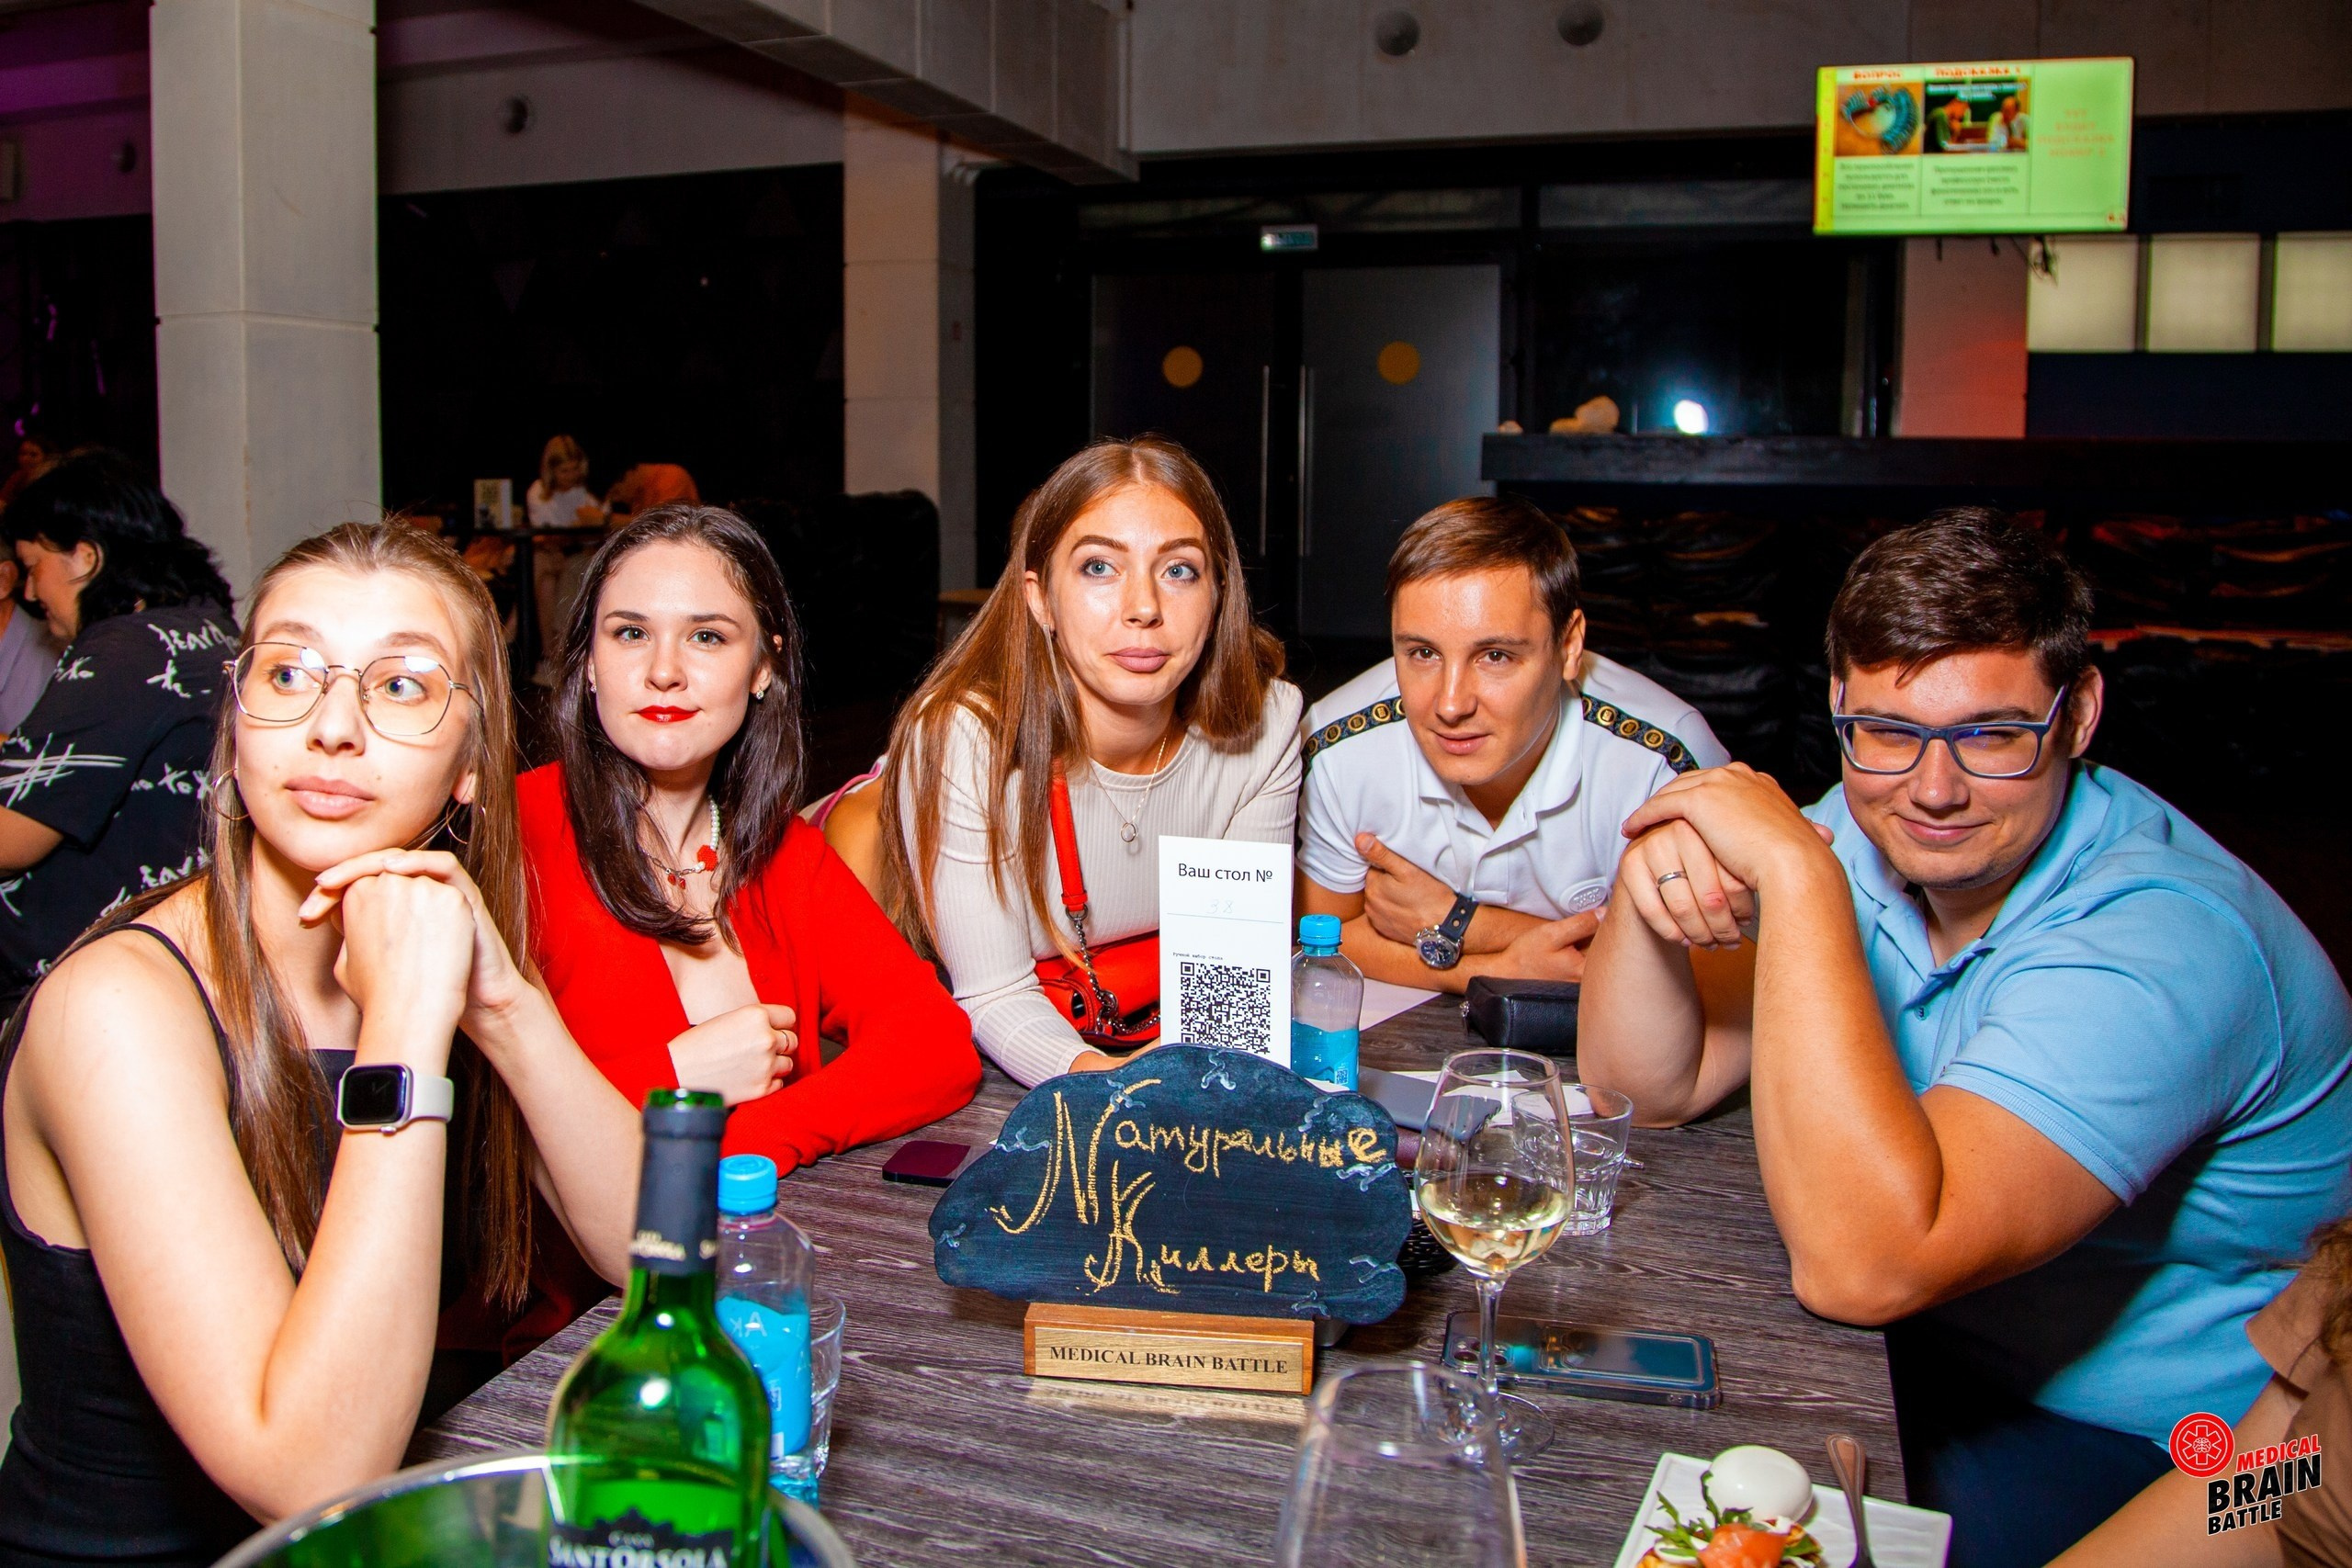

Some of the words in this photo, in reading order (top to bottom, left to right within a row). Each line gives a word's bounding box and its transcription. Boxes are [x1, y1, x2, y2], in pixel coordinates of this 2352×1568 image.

[1178, 863, 1210, 878] Ваш
[1215, 869, 1250, 882] стол
[1256, 869, 1273, 883] №
[1050, 1346, 1140, 1365] MEDICAL
[1146, 1353, 1205, 1369] BRAIN
[1213, 1357, 1288, 1374] BATTLE
